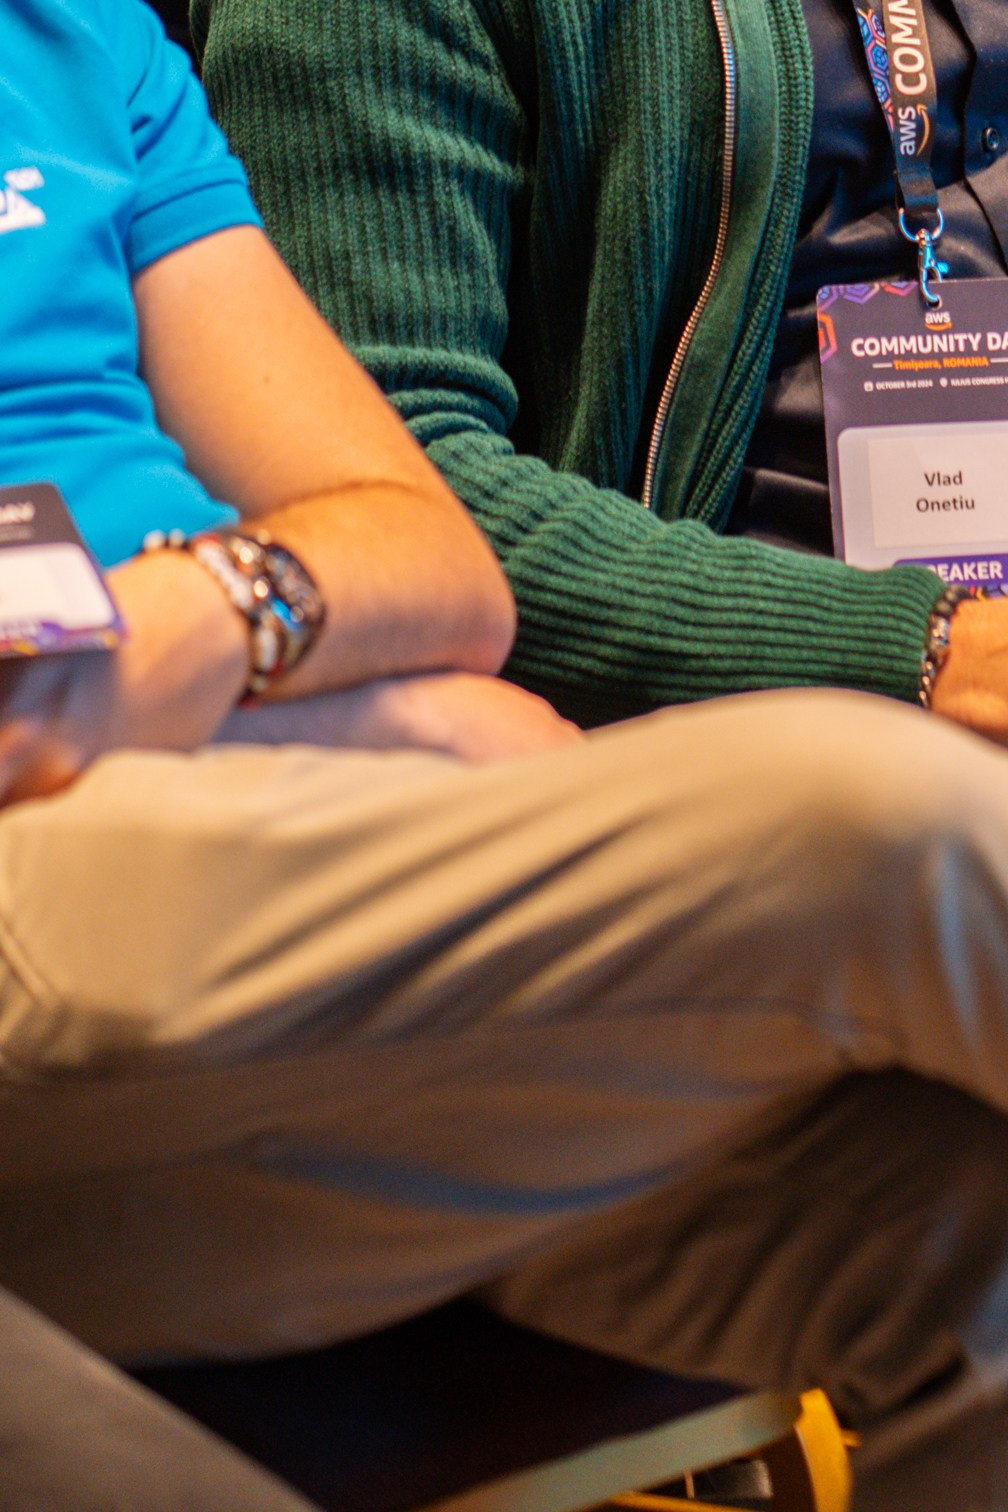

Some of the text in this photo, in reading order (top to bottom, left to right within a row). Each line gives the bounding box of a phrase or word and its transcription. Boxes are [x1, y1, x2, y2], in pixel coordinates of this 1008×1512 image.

[898, 105, 917, 156] aws
[925, 311, 950, 324] aws
[851, 332, 982, 357] COMMUNITY
[943, 356, 989, 369] ROMANIA
[875, 381, 905, 390] OCTOBER
[924, 470, 963, 487] Vlad
[916, 495, 975, 513] Onetiu
[928, 560, 1004, 582] EAKER
